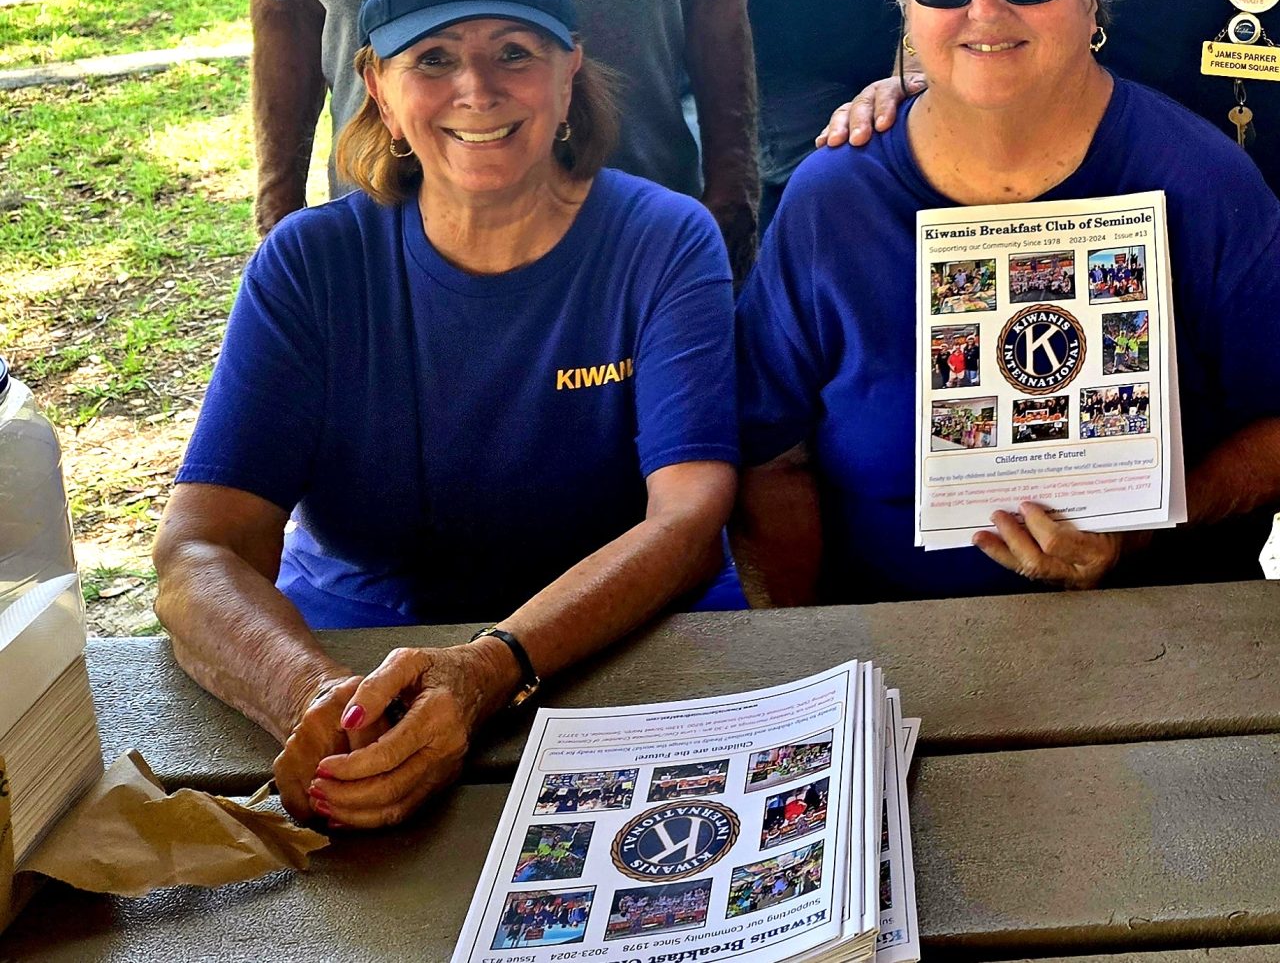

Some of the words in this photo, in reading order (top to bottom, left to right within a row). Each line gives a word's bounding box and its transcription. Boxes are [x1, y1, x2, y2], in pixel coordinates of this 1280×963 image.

[1215, 51, 1242, 60] JAMES
[1244, 53, 1276, 62] PARKER
[1210, 61, 1247, 70] FREEDOM
[1248, 64, 1280, 72] SQUARE
[925, 227, 976, 239] Kiwanis
[980, 223, 1042, 236] Breakfast
[1046, 220, 1075, 231] Club
[1079, 219, 1092, 229] of
[1094, 213, 1152, 228] Seminole
[929, 245, 967, 253] Supporting
[982, 241, 1021, 249] Community
[1069, 235, 1106, 243] 2023-2024
[1013, 312, 1070, 334] KIWANIS
[1025, 324, 1061, 376] K
[1005, 340, 1078, 387] INTERNATIONAL
[996, 455, 1028, 464] Children
[1059, 449, 1086, 459] Future!
[712, 742, 753, 752] Children
[635, 753, 671, 761] Future!
[623, 807, 730, 852] INTERNATIONAL
[647, 817, 701, 863] K
[630, 851, 713, 874] KIWANIS
[767, 898, 821, 922] Supporting
[746, 919, 764, 928] our
[750, 909, 827, 944] Kiwanis
[653, 938, 680, 947] Since
[684, 925, 743, 942] Community
[551, 948, 609, 960] 2023-2024
[622, 943, 649, 952] 1978
[648, 938, 745, 963] Breakfast
